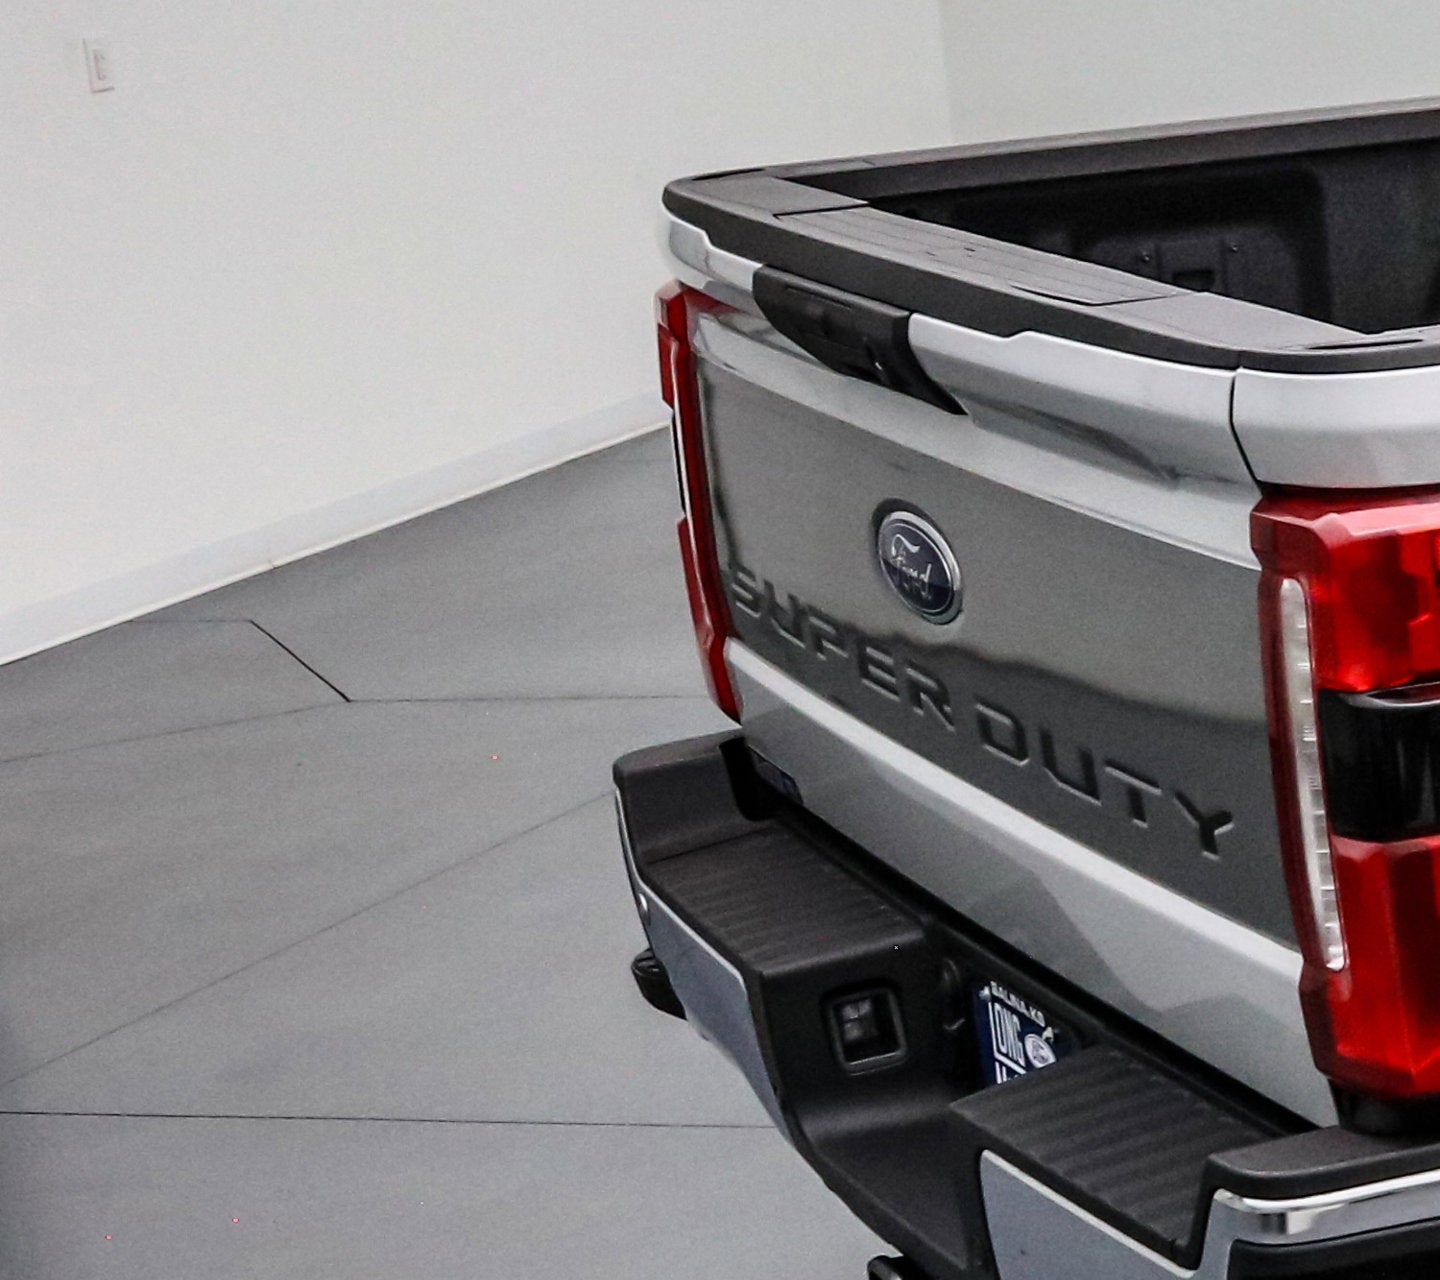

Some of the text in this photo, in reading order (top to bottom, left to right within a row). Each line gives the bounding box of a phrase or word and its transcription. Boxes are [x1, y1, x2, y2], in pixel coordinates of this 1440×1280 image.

[890, 532, 932, 602] Ford
[730, 568, 1235, 863] SUPER DUTY
